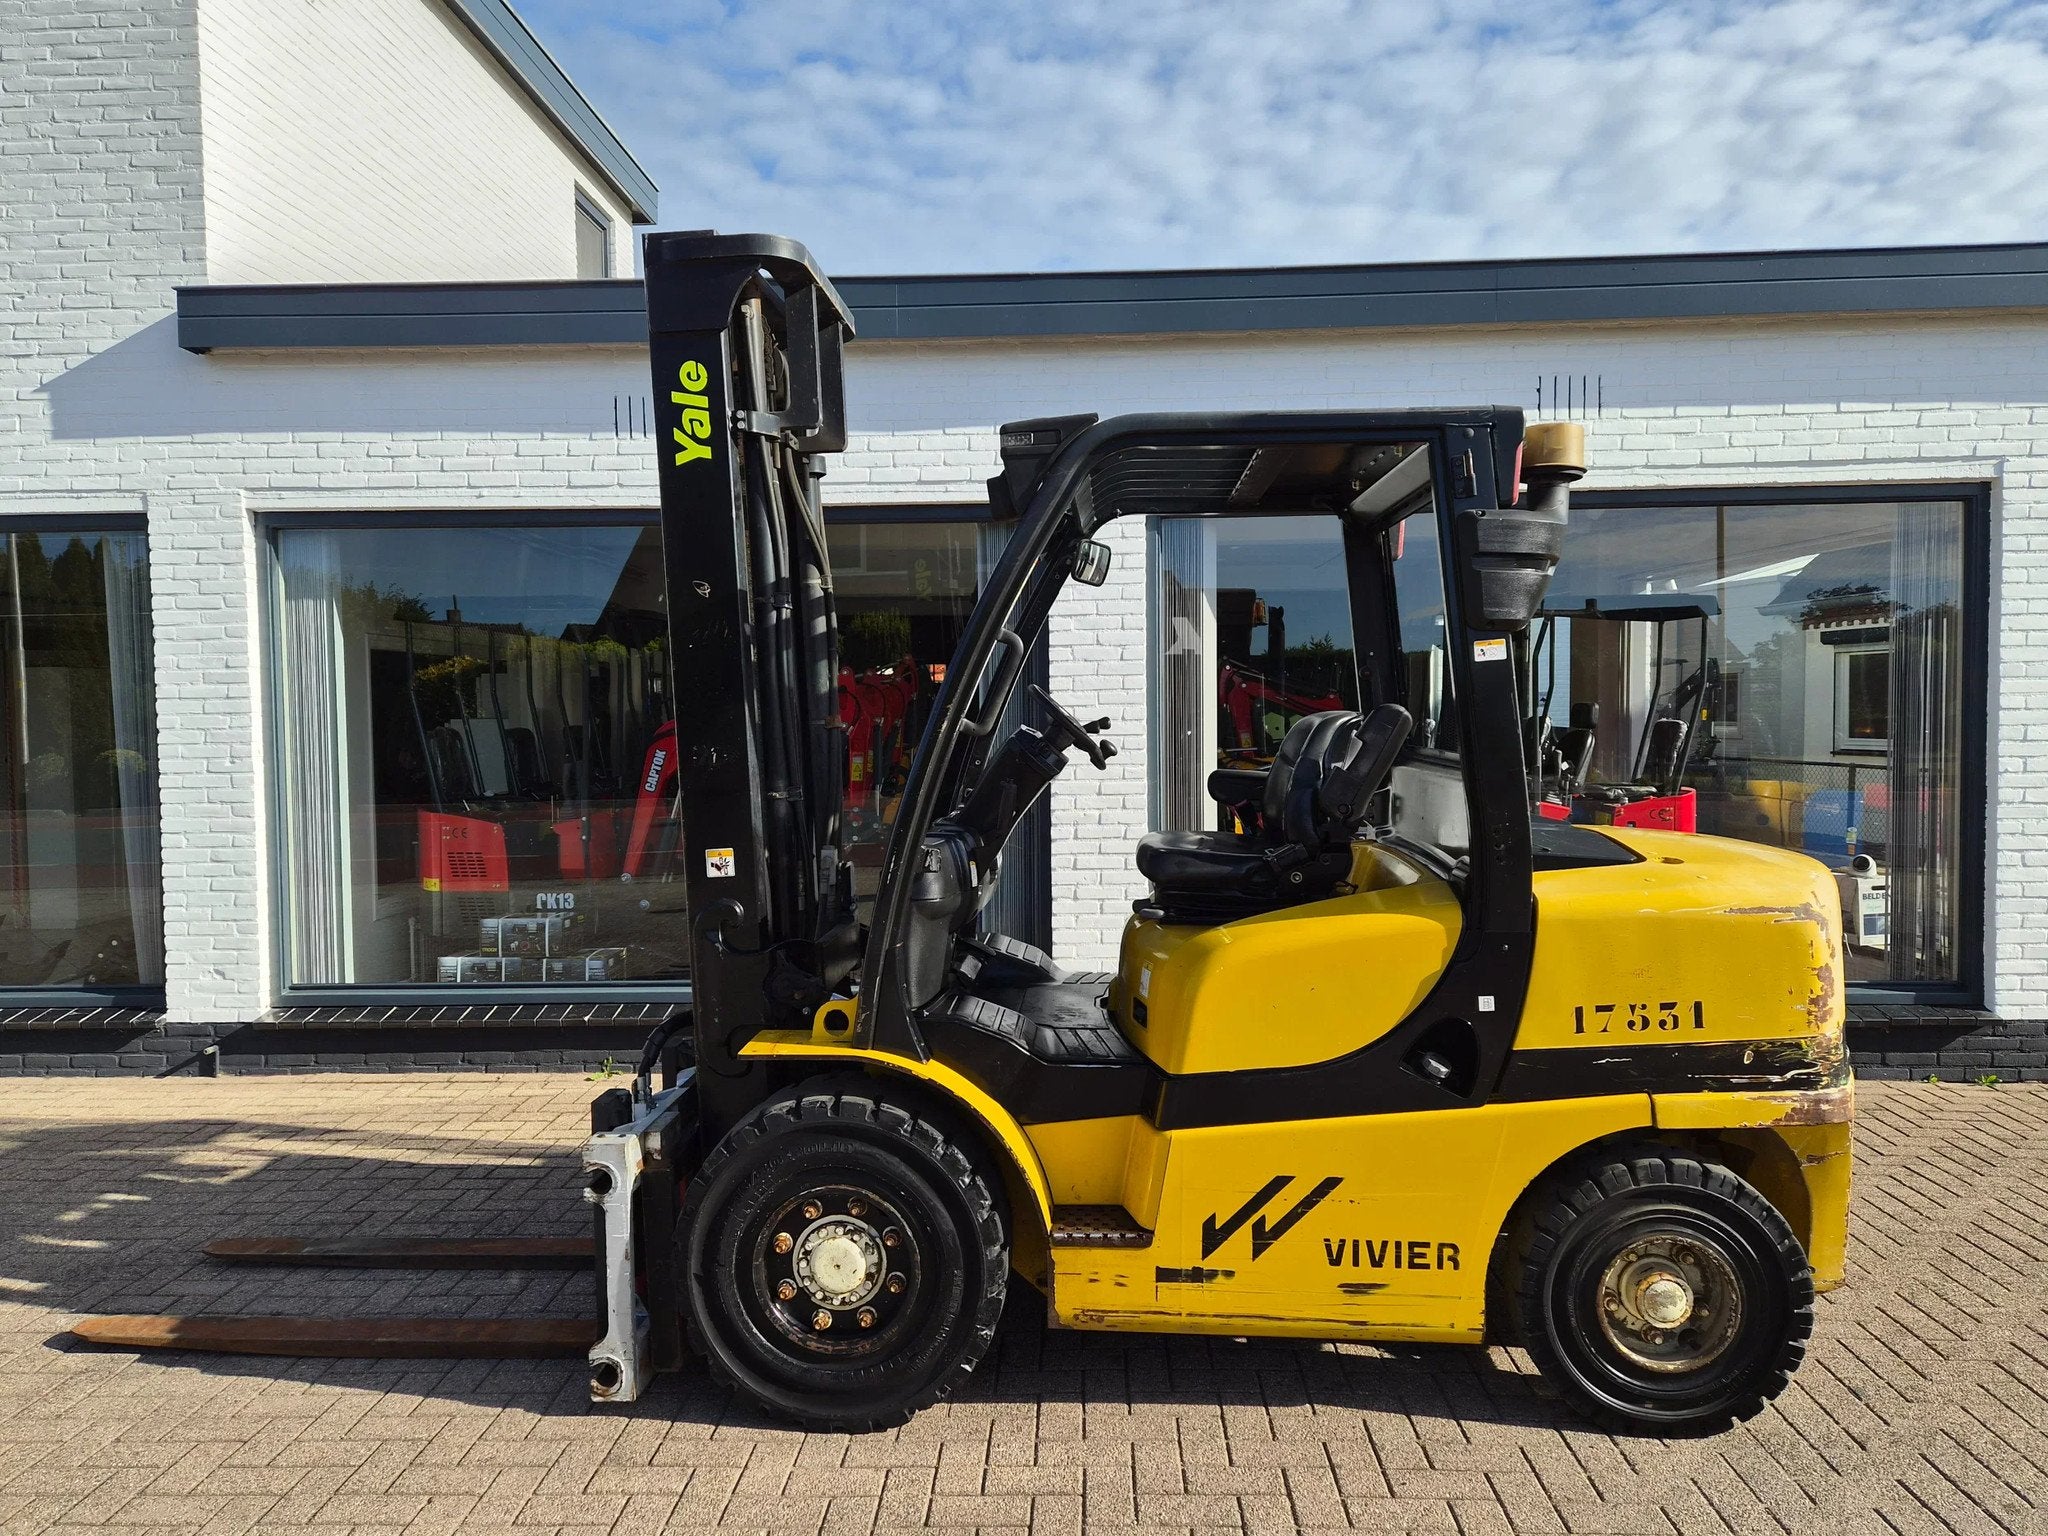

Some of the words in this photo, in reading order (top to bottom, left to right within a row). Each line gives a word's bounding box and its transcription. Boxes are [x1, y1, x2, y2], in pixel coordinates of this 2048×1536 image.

[671, 360, 713, 467] Yale
[644, 749, 667, 792] CAPTOK
[451, 826, 468, 839] CE
[1571, 1000, 1706, 1034] 17531
[1322, 1237, 1461, 1271] VIVIER
